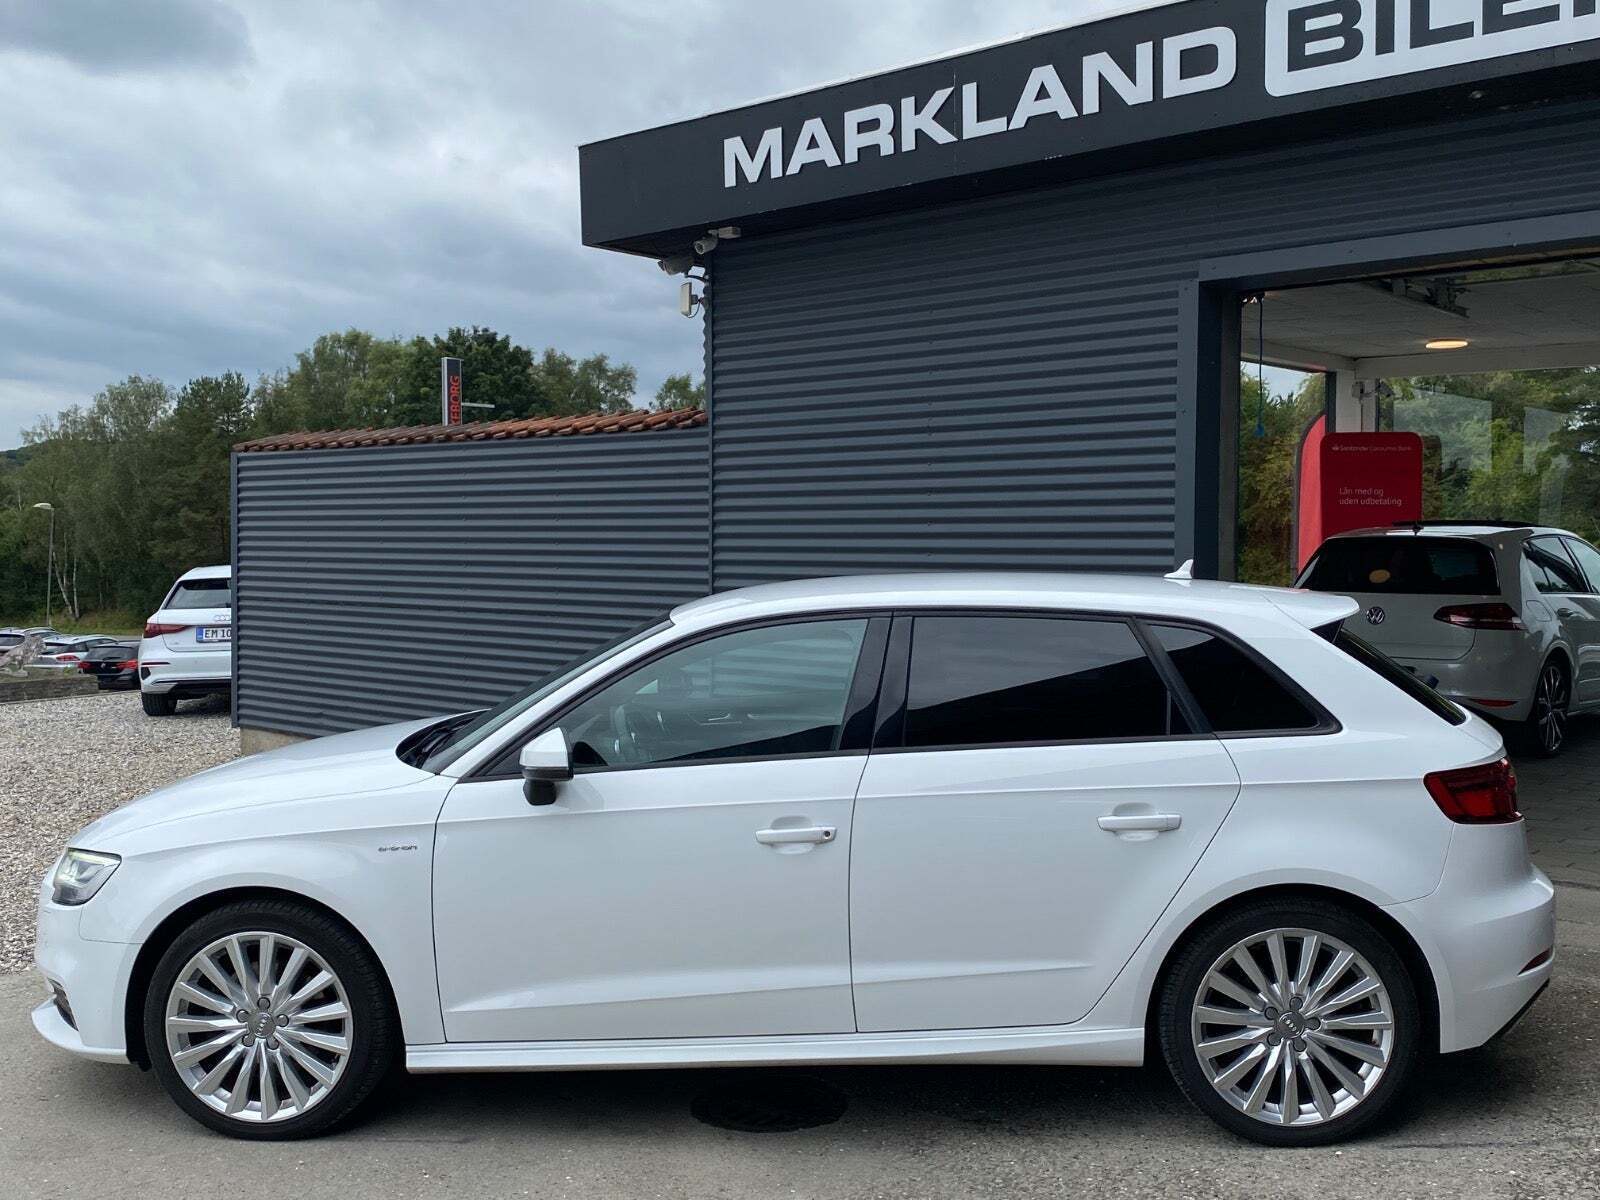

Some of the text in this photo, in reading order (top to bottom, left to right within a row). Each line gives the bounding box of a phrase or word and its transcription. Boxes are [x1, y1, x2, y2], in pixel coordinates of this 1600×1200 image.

[724, 26, 1237, 188] MARKLAND
[1339, 487, 1353, 495] Lån
[1373, 489, 1384, 497] og
[1360, 498, 1402, 507] udbetaling
[205, 629, 218, 638] EM
